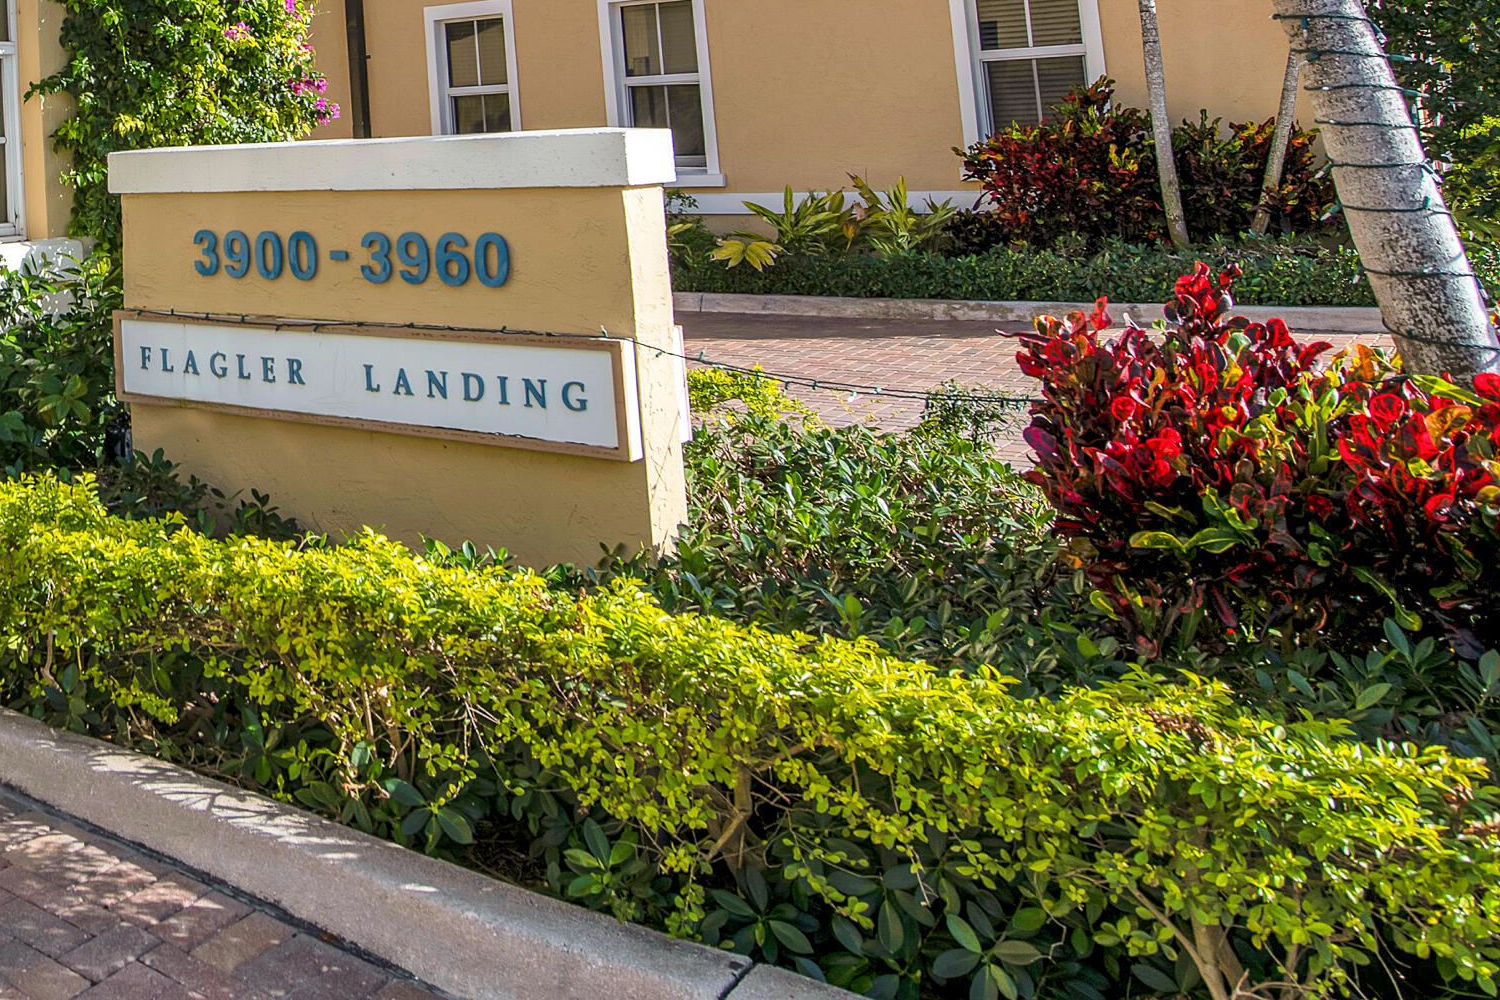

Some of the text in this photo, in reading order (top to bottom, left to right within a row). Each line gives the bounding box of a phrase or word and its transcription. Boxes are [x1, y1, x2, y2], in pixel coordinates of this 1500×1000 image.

[193, 229, 510, 288] 3900-3960
[139, 345, 588, 412] FLAGLER LANDING
